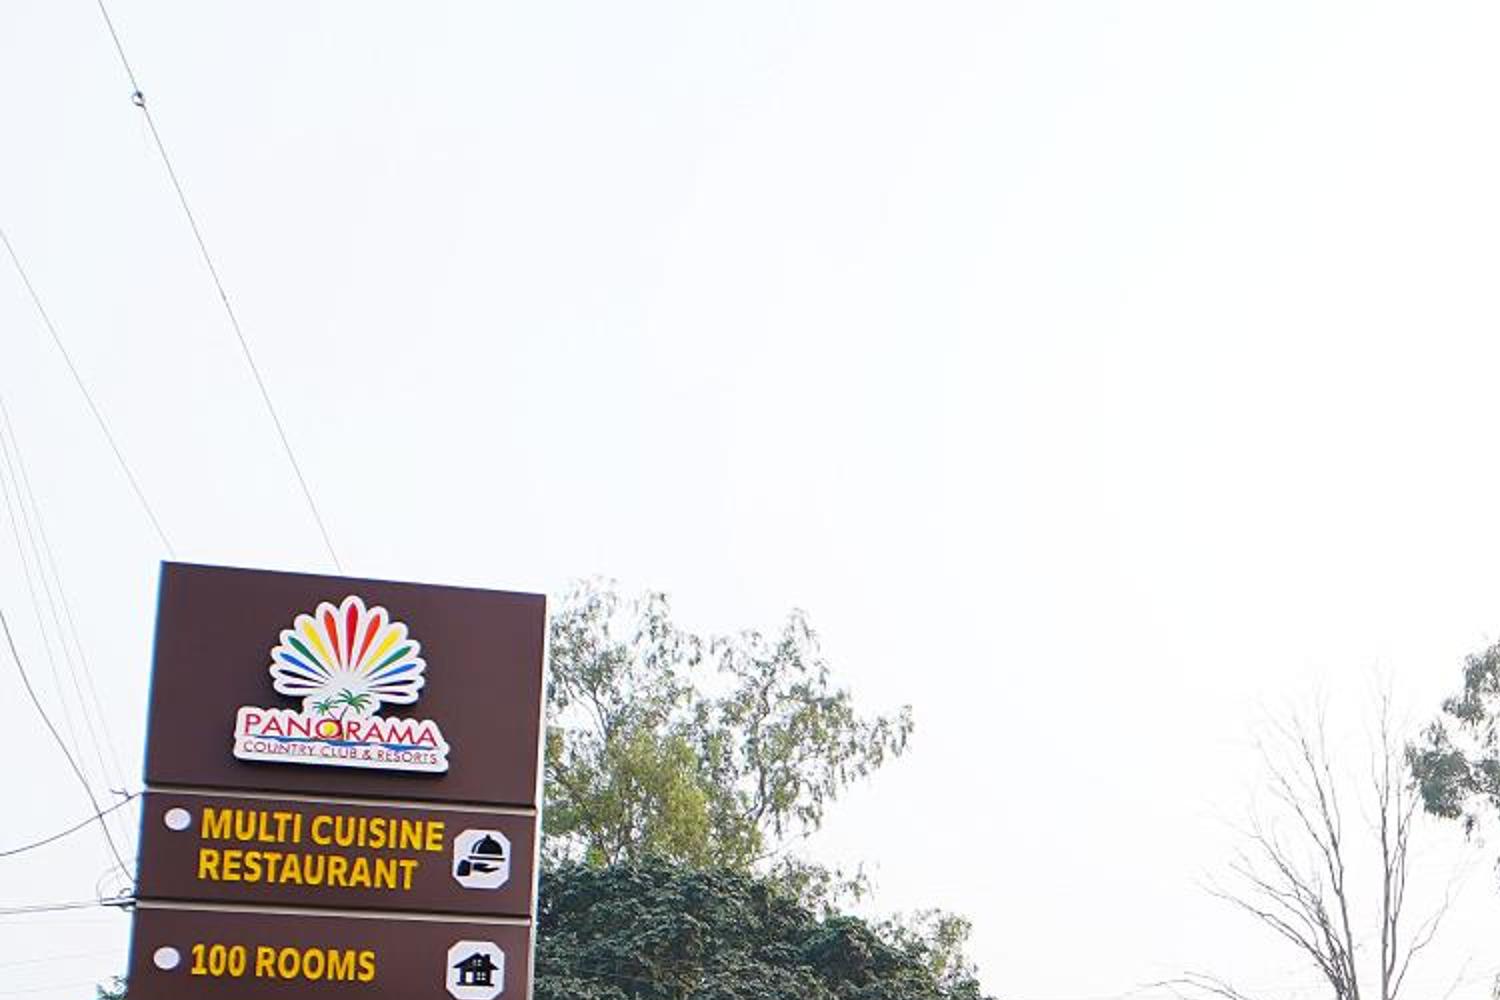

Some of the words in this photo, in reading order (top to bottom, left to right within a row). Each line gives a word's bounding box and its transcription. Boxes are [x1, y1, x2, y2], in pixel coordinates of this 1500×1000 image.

[244, 713, 438, 747] PANORAMA
[243, 741, 314, 757] COUNTRY
[319, 746, 357, 760] CLUB
[362, 748, 373, 761] &
[377, 750, 438, 765] RESORTS
[201, 807, 303, 846] MULTI
[311, 813, 445, 852] CUISINE
[198, 847, 419, 891] RESTAURANT
[190, 943, 247, 979] 100
[255, 946, 376, 982] ROOMS
